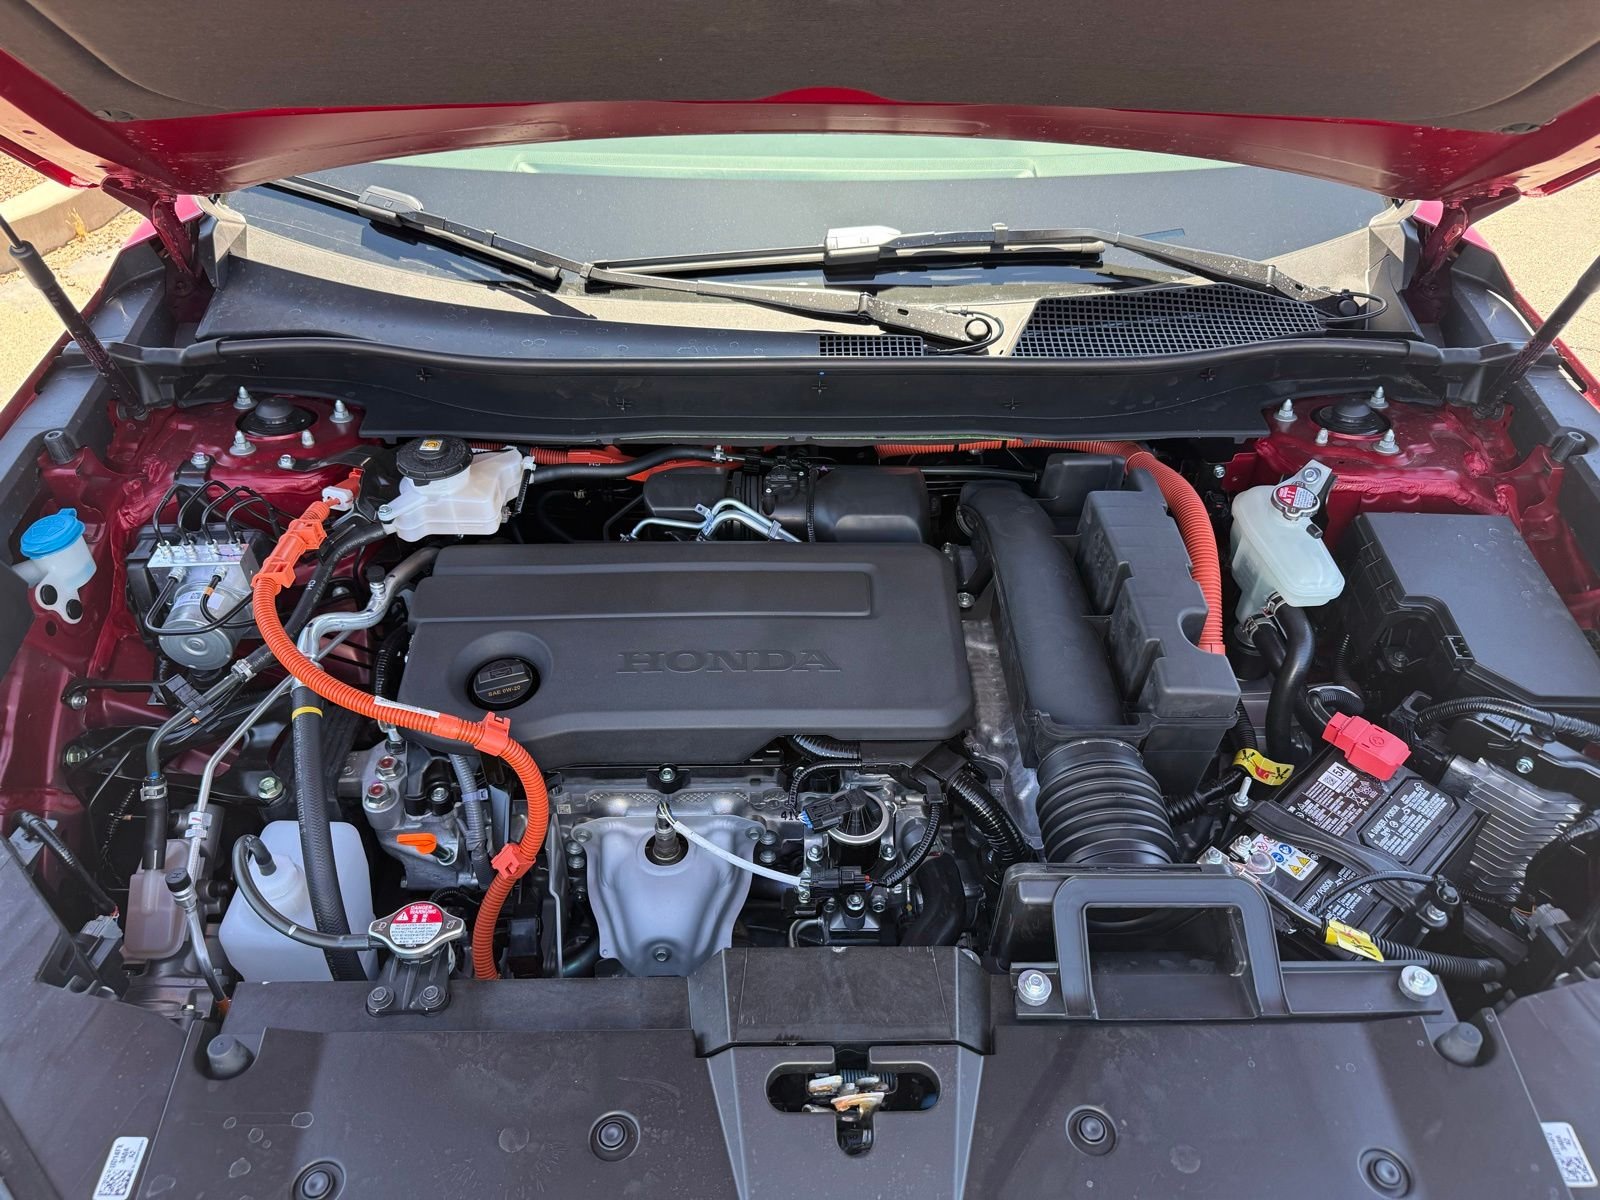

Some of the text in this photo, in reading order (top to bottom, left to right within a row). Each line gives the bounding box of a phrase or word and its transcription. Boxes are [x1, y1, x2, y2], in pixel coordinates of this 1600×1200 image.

[616, 650, 841, 674] HONDA
[488, 689, 502, 697] SAE
[1332, 765, 1349, 779] 5A
